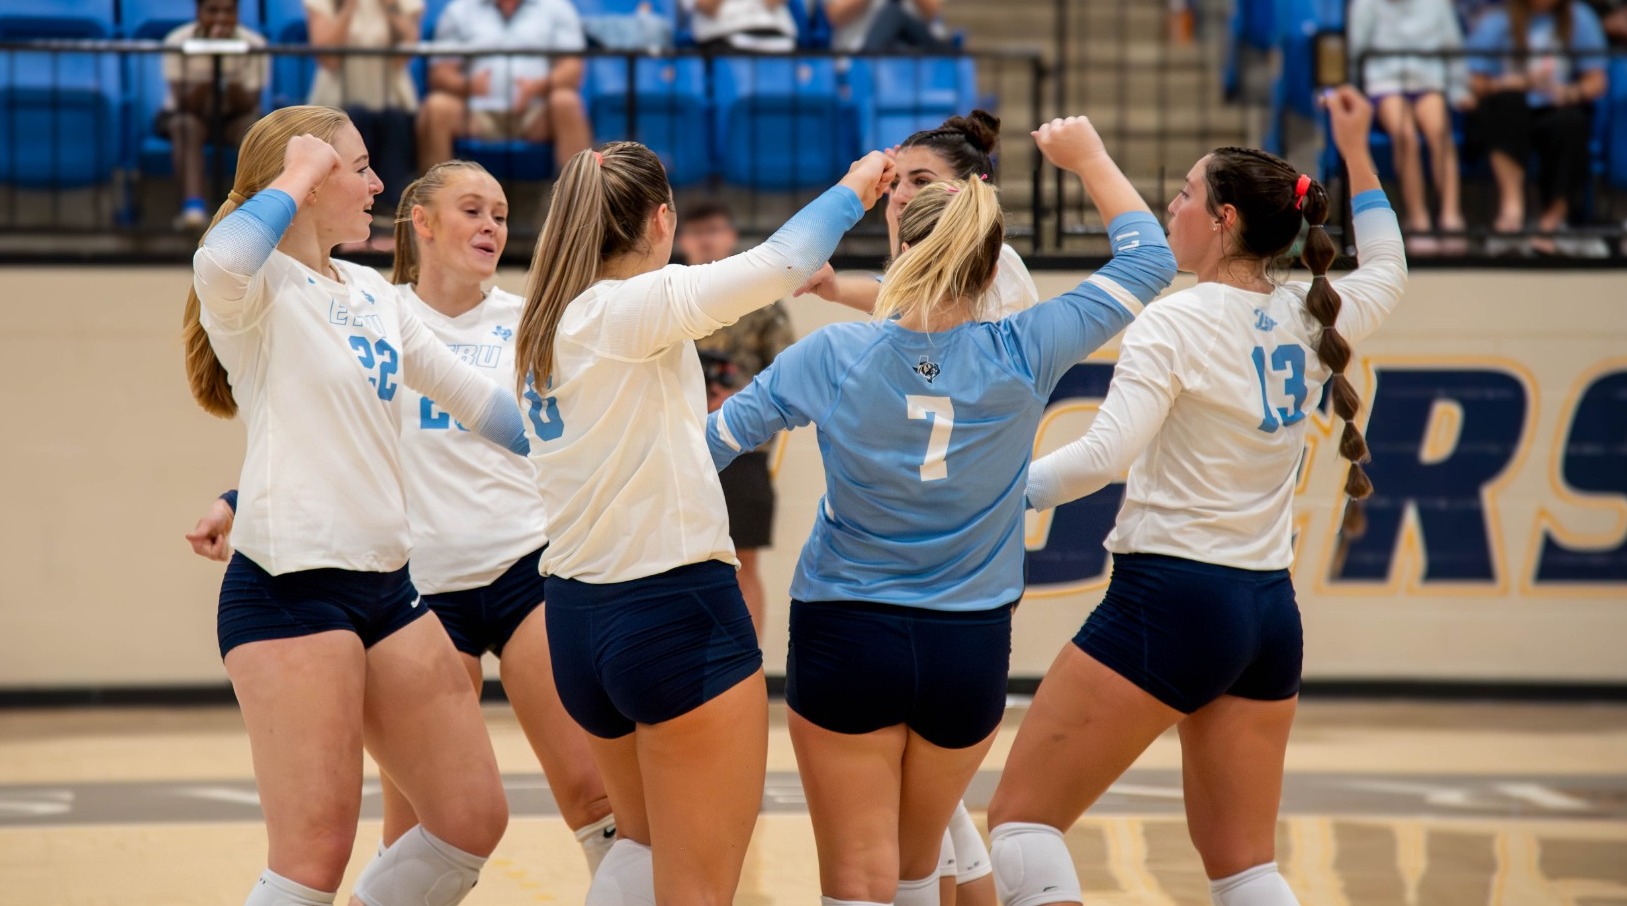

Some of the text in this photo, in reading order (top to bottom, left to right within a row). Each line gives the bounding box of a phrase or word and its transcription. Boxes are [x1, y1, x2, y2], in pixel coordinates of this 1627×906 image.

[348, 335, 398, 402] 22
[1251, 344, 1308, 434] 13
[905, 394, 955, 482] 7
